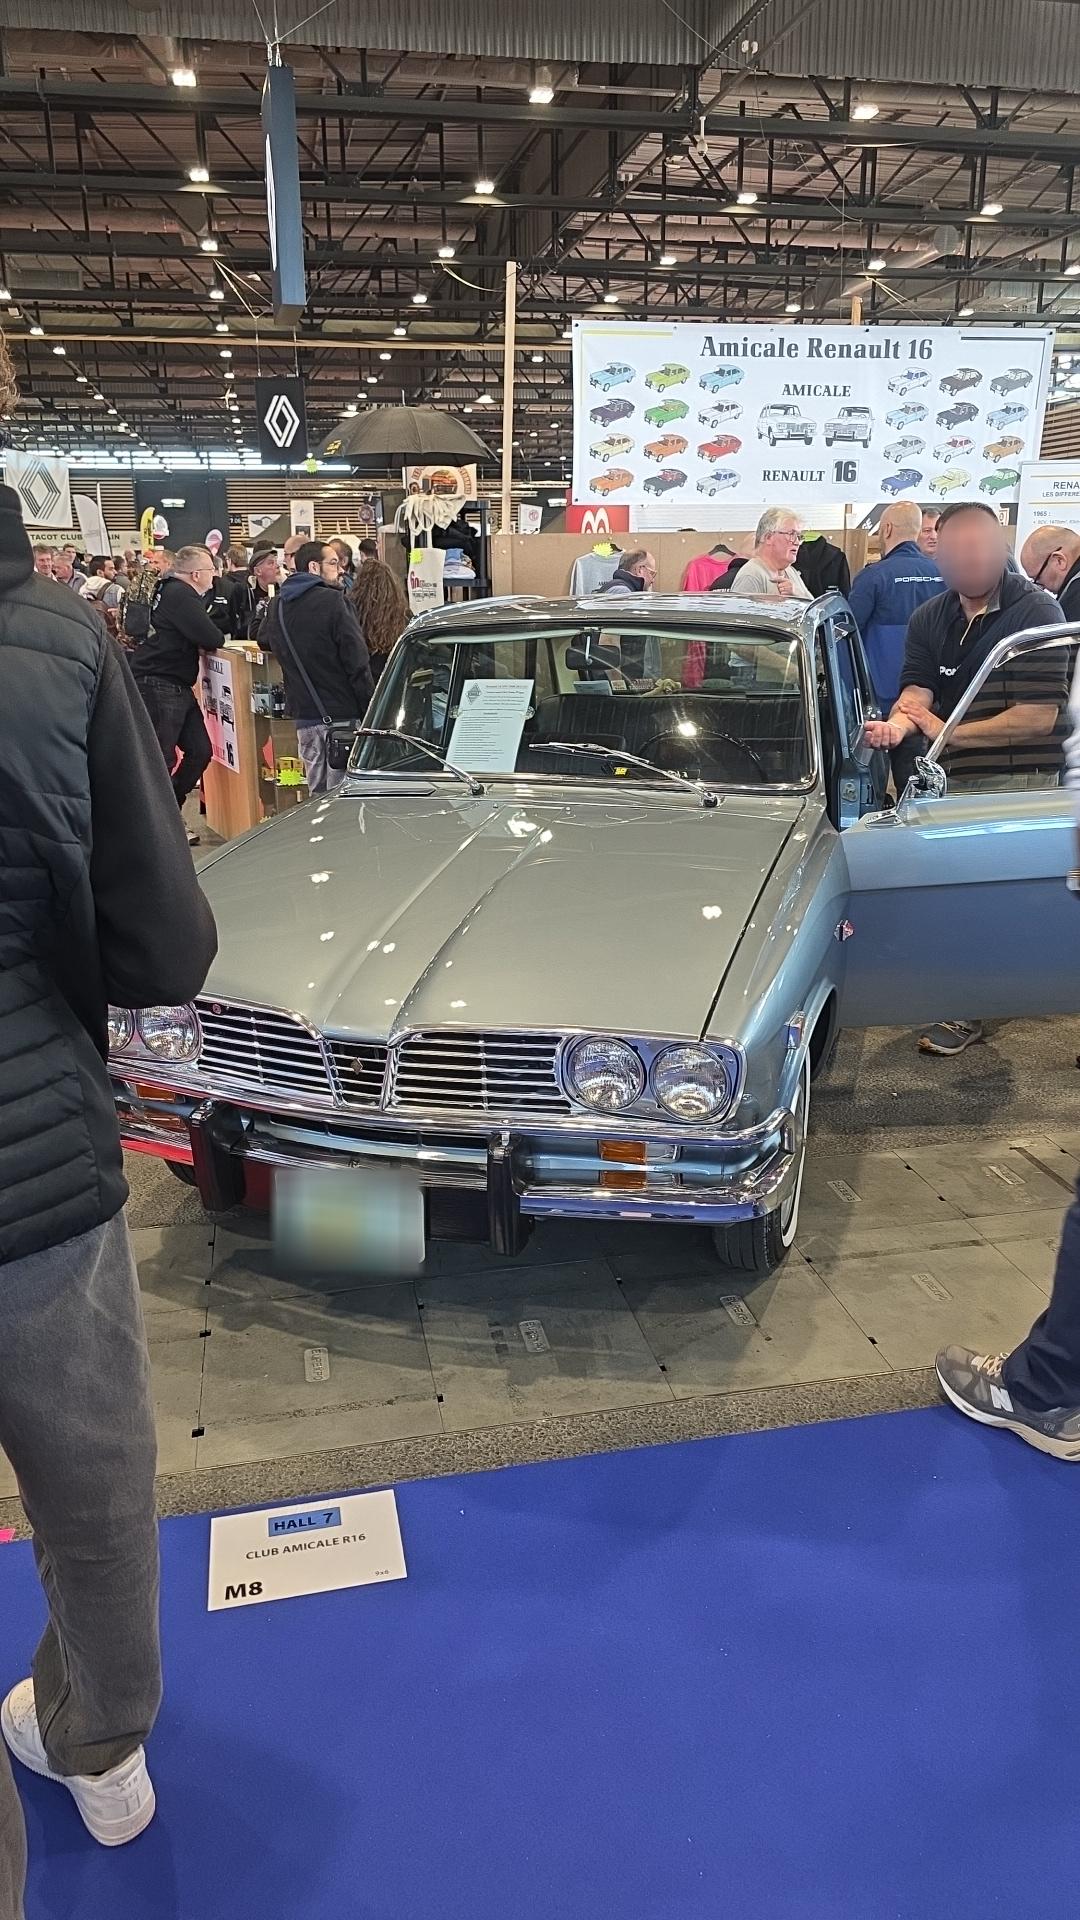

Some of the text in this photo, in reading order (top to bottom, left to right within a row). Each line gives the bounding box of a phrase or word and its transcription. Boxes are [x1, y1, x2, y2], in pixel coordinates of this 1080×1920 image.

[700, 336, 933, 360] Amicale Renault 16
[781, 384, 851, 397] AMICALE
[762, 460, 857, 483] RENAULT 16
[895, 576, 945, 584] PORSCHE
[274, 1512, 334, 1532] HALL 7
[246, 1533, 367, 1560] CLUB AMICALE R16
[225, 1581, 263, 1601] M8
